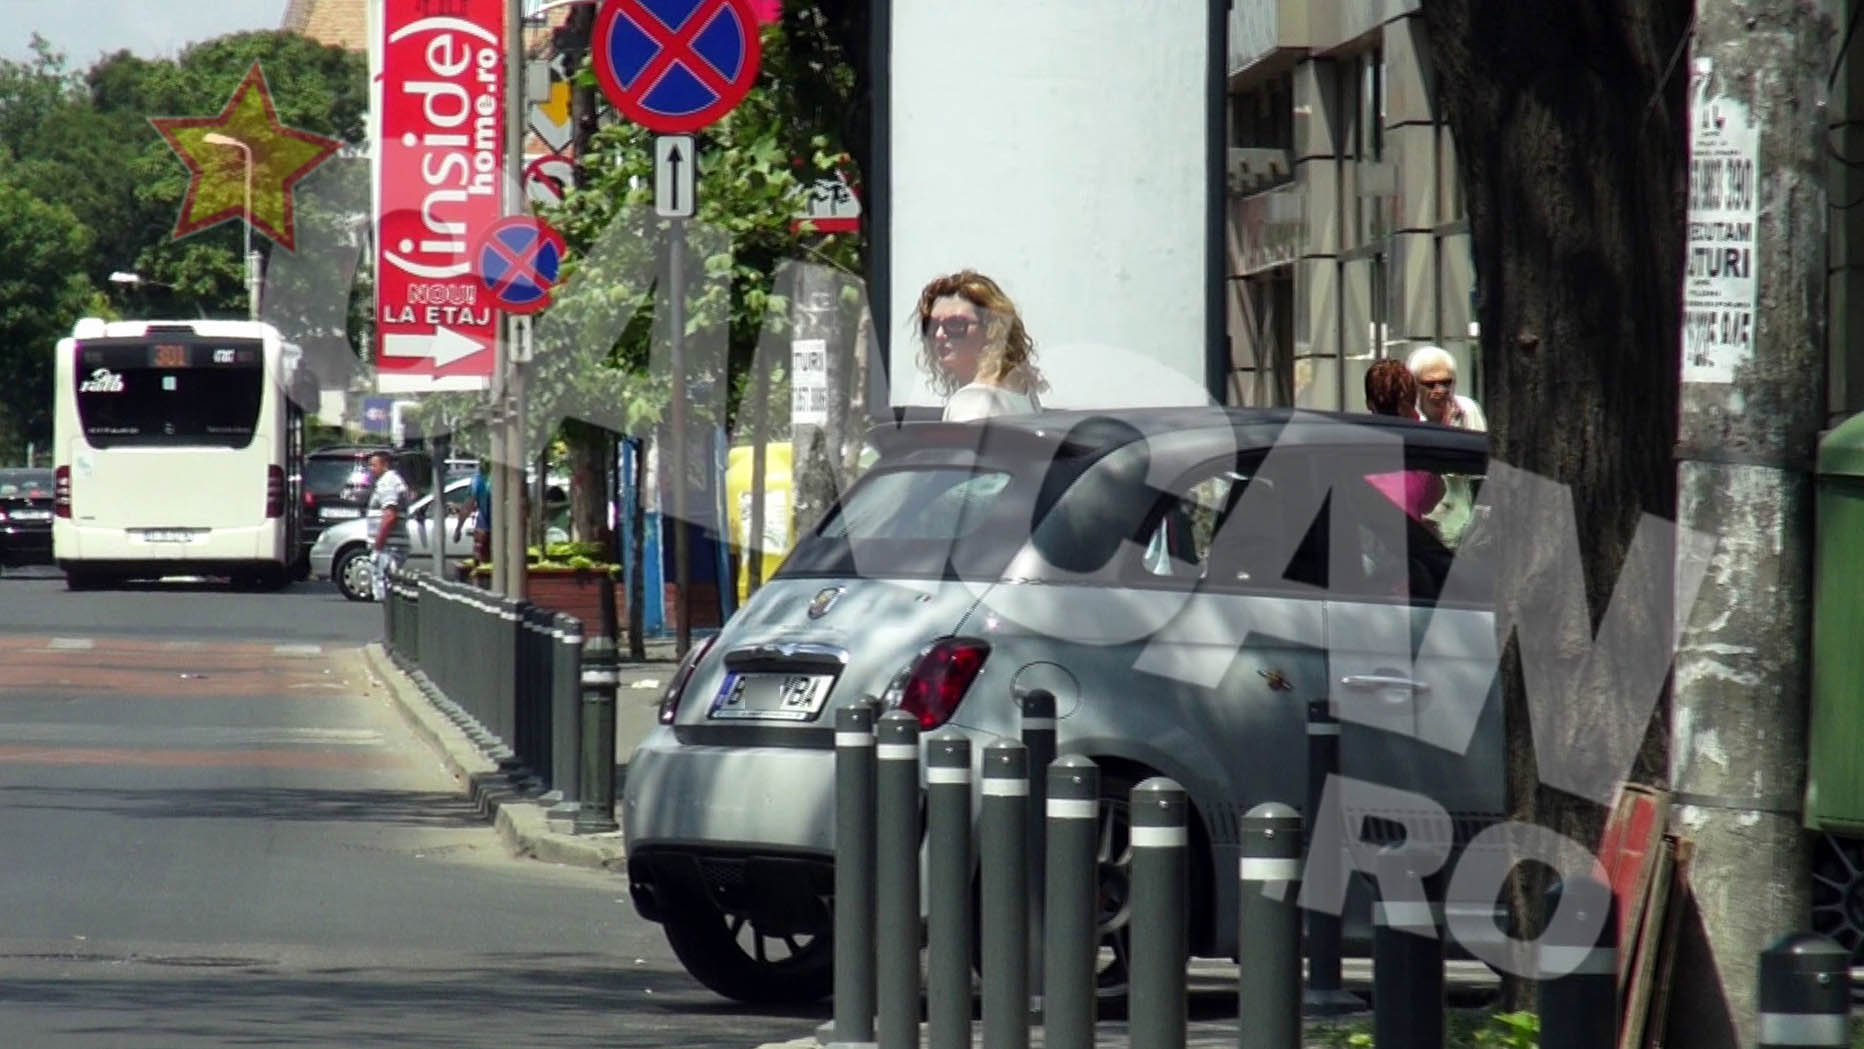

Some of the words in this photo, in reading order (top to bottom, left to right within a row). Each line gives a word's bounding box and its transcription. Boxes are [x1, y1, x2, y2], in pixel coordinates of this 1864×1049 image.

[468, 47, 498, 195] home.ro
[407, 283, 477, 304] NOU!
[383, 305, 416, 323] LA
[425, 307, 490, 325] ETAJ
